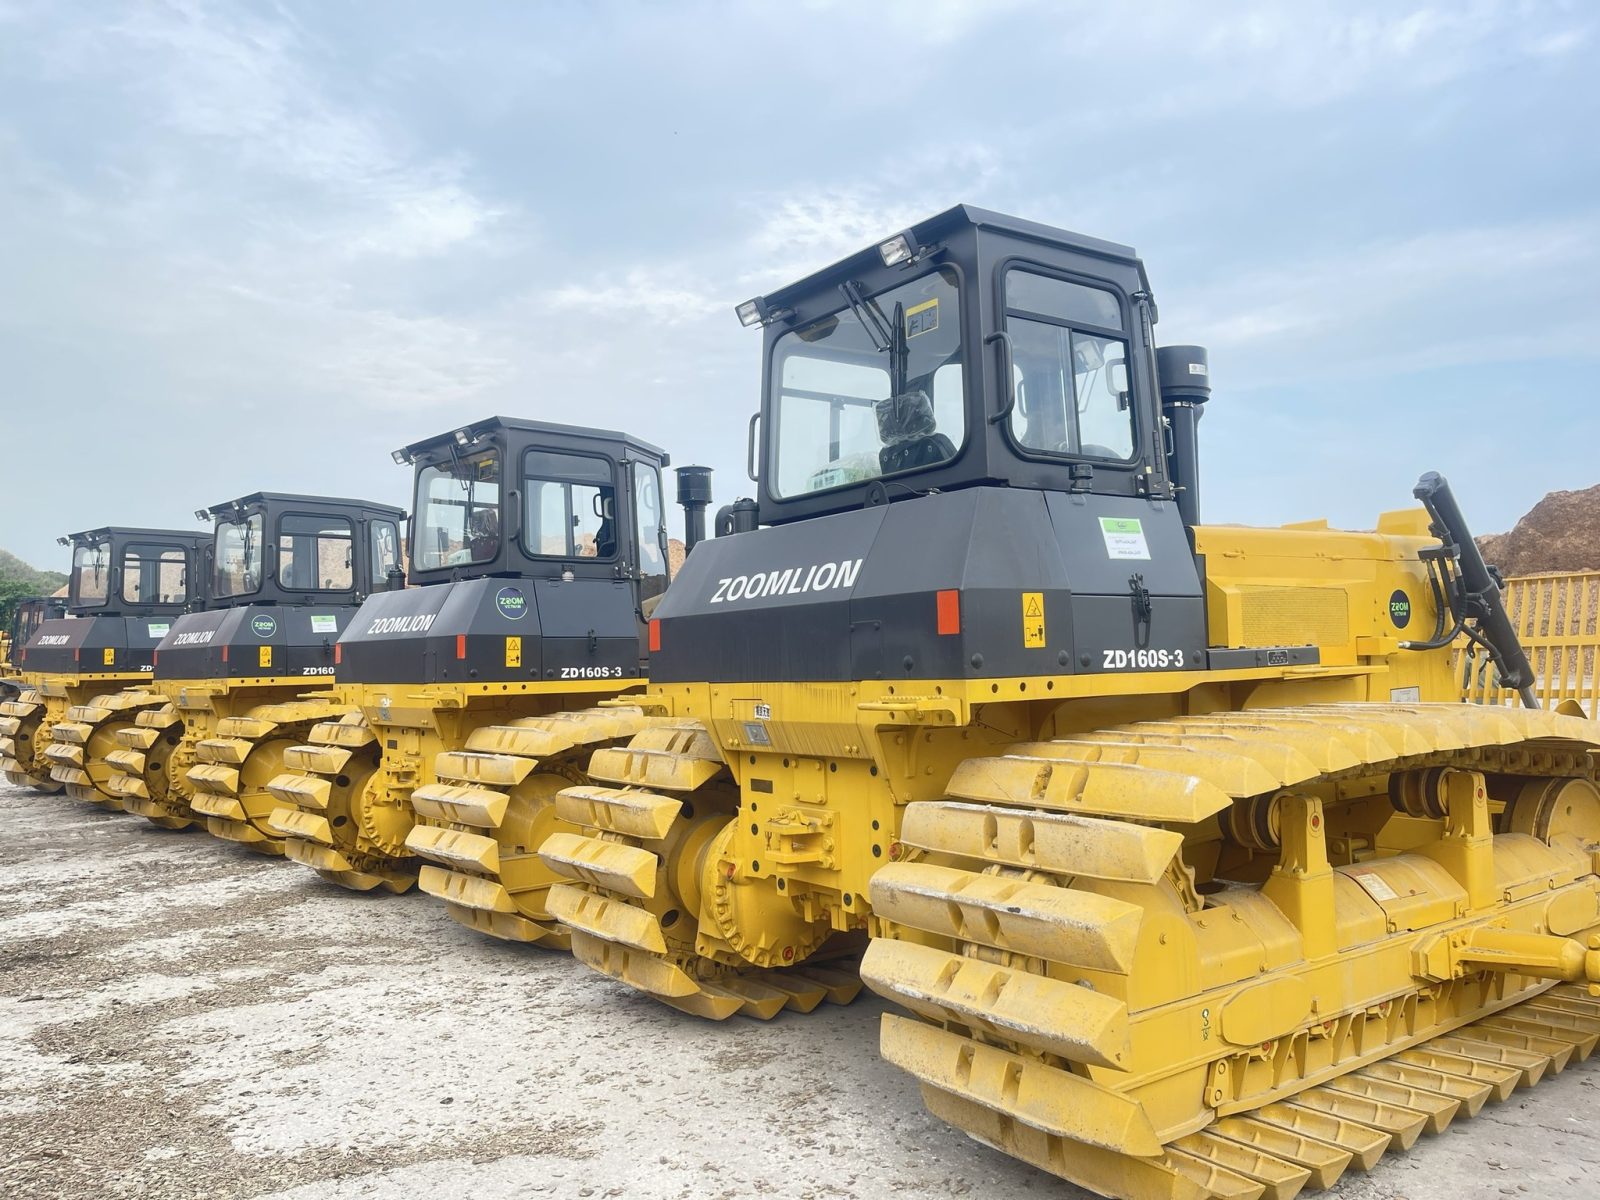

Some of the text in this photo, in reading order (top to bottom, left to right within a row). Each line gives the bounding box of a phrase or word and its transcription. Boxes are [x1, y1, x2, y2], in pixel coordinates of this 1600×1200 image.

[710, 559, 863, 603] ZOOMLION
[367, 614, 437, 634] ZOOMLION
[173, 630, 215, 645] ZOOMLION
[1103, 649, 1184, 668] ZD160S-3
[560, 666, 622, 679] ZD160S-3
